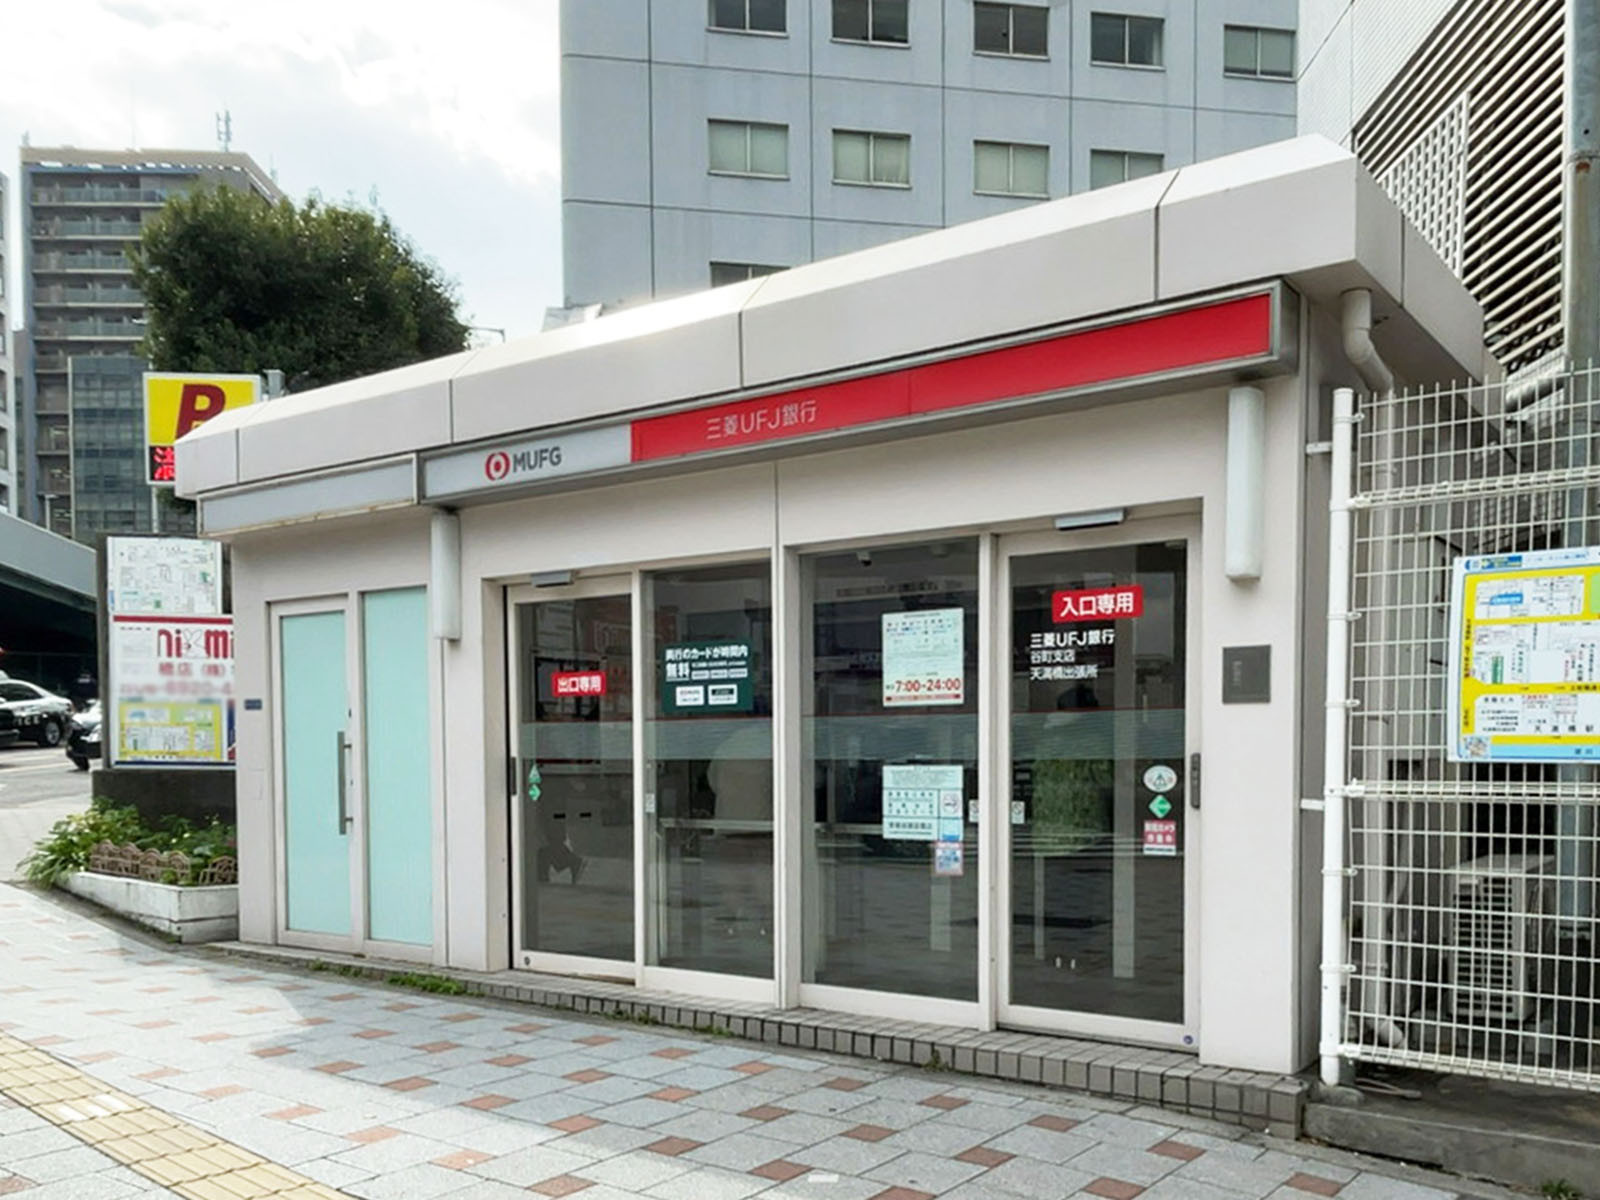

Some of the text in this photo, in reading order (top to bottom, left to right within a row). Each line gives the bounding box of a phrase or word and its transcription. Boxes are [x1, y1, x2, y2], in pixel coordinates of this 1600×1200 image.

[176, 384, 226, 440] P
[707, 400, 817, 440] 三菱UFJ銀行
[512, 446, 562, 473] MUFG
[1060, 592, 1134, 617] 入口専用
[1030, 629, 1114, 648] 三菱UFJ銀行
[1030, 649, 1076, 664] 谷町支店
[557, 675, 602, 692] 出口専用
